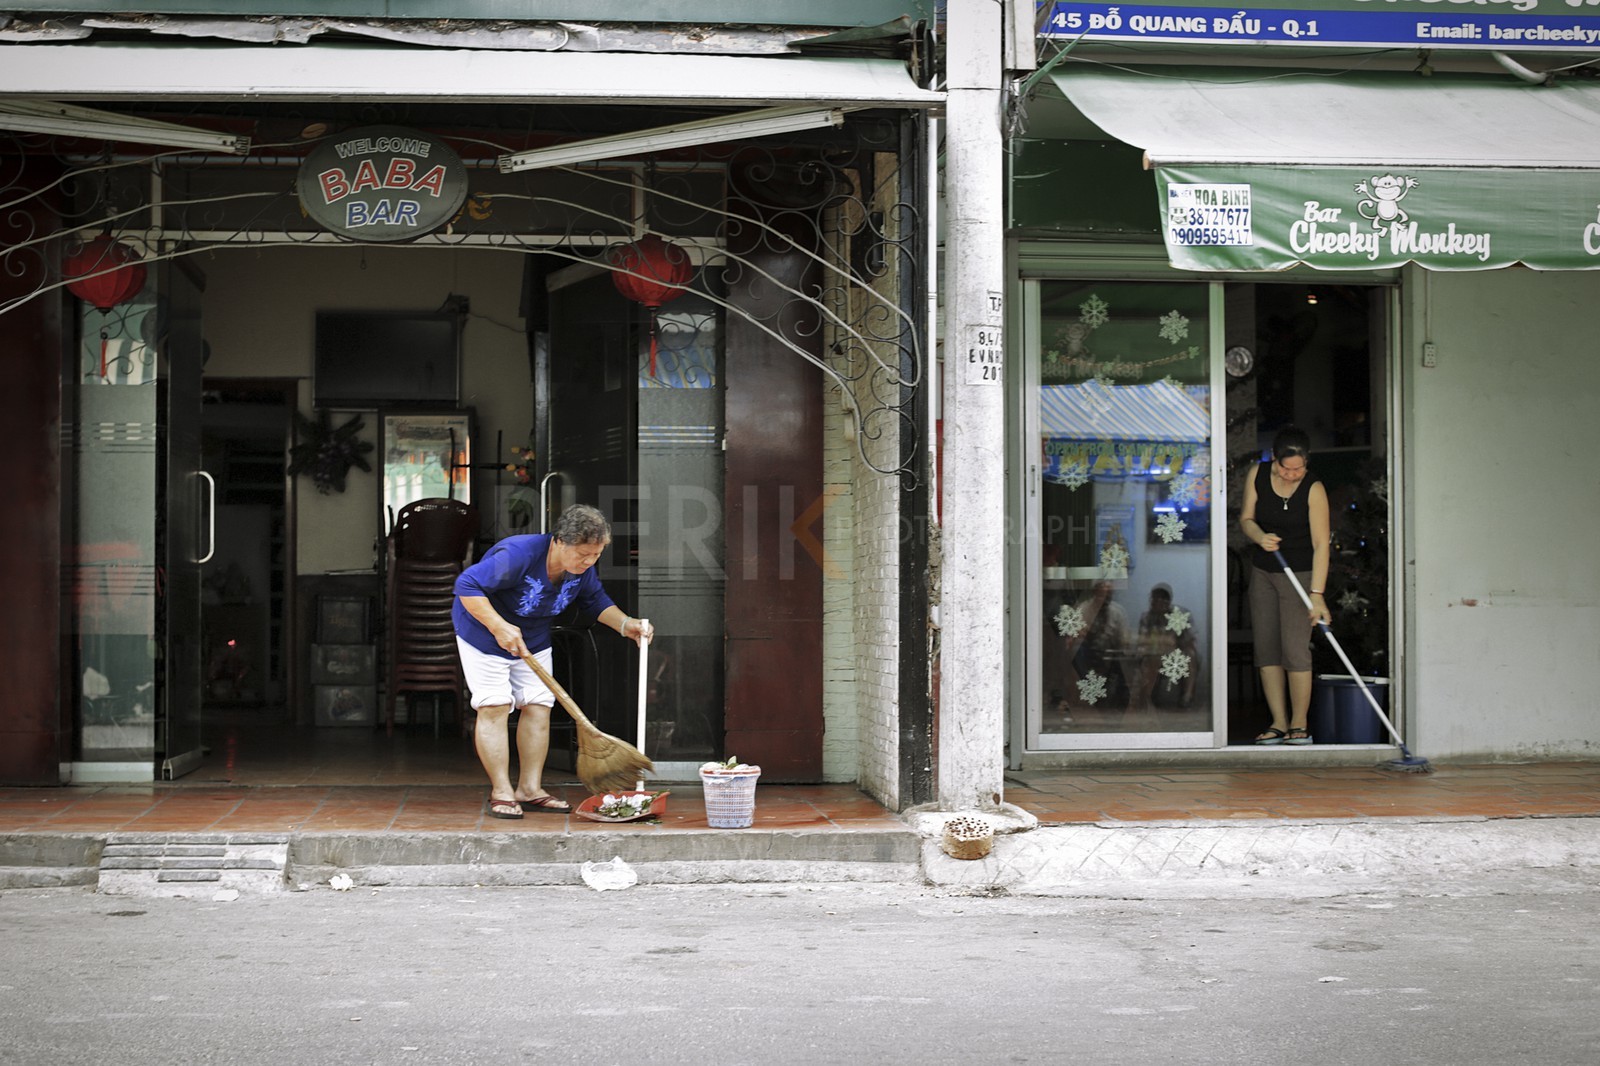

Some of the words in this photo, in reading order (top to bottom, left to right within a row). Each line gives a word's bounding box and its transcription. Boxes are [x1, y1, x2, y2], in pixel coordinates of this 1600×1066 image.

[1052, 12, 1082, 28] 45
[1089, 7, 1123, 30] ĐỖ
[1128, 15, 1207, 34] QUANG
[1282, 19, 1319, 38] Q.1
[1416, 22, 1482, 39] Email:
[1488, 24, 1600, 43] barcheeky
[334, 137, 432, 159] WELCOME
[317, 157, 447, 205] BABA
[345, 199, 420, 229] BAR
[1188, 207, 1249, 226] 38727677
[1303, 200, 1342, 223] Bar
[1171, 227, 1250, 244] 0909595417
[1289, 219, 1381, 261] Cheeky
[1389, 220, 1491, 262] Monkey
